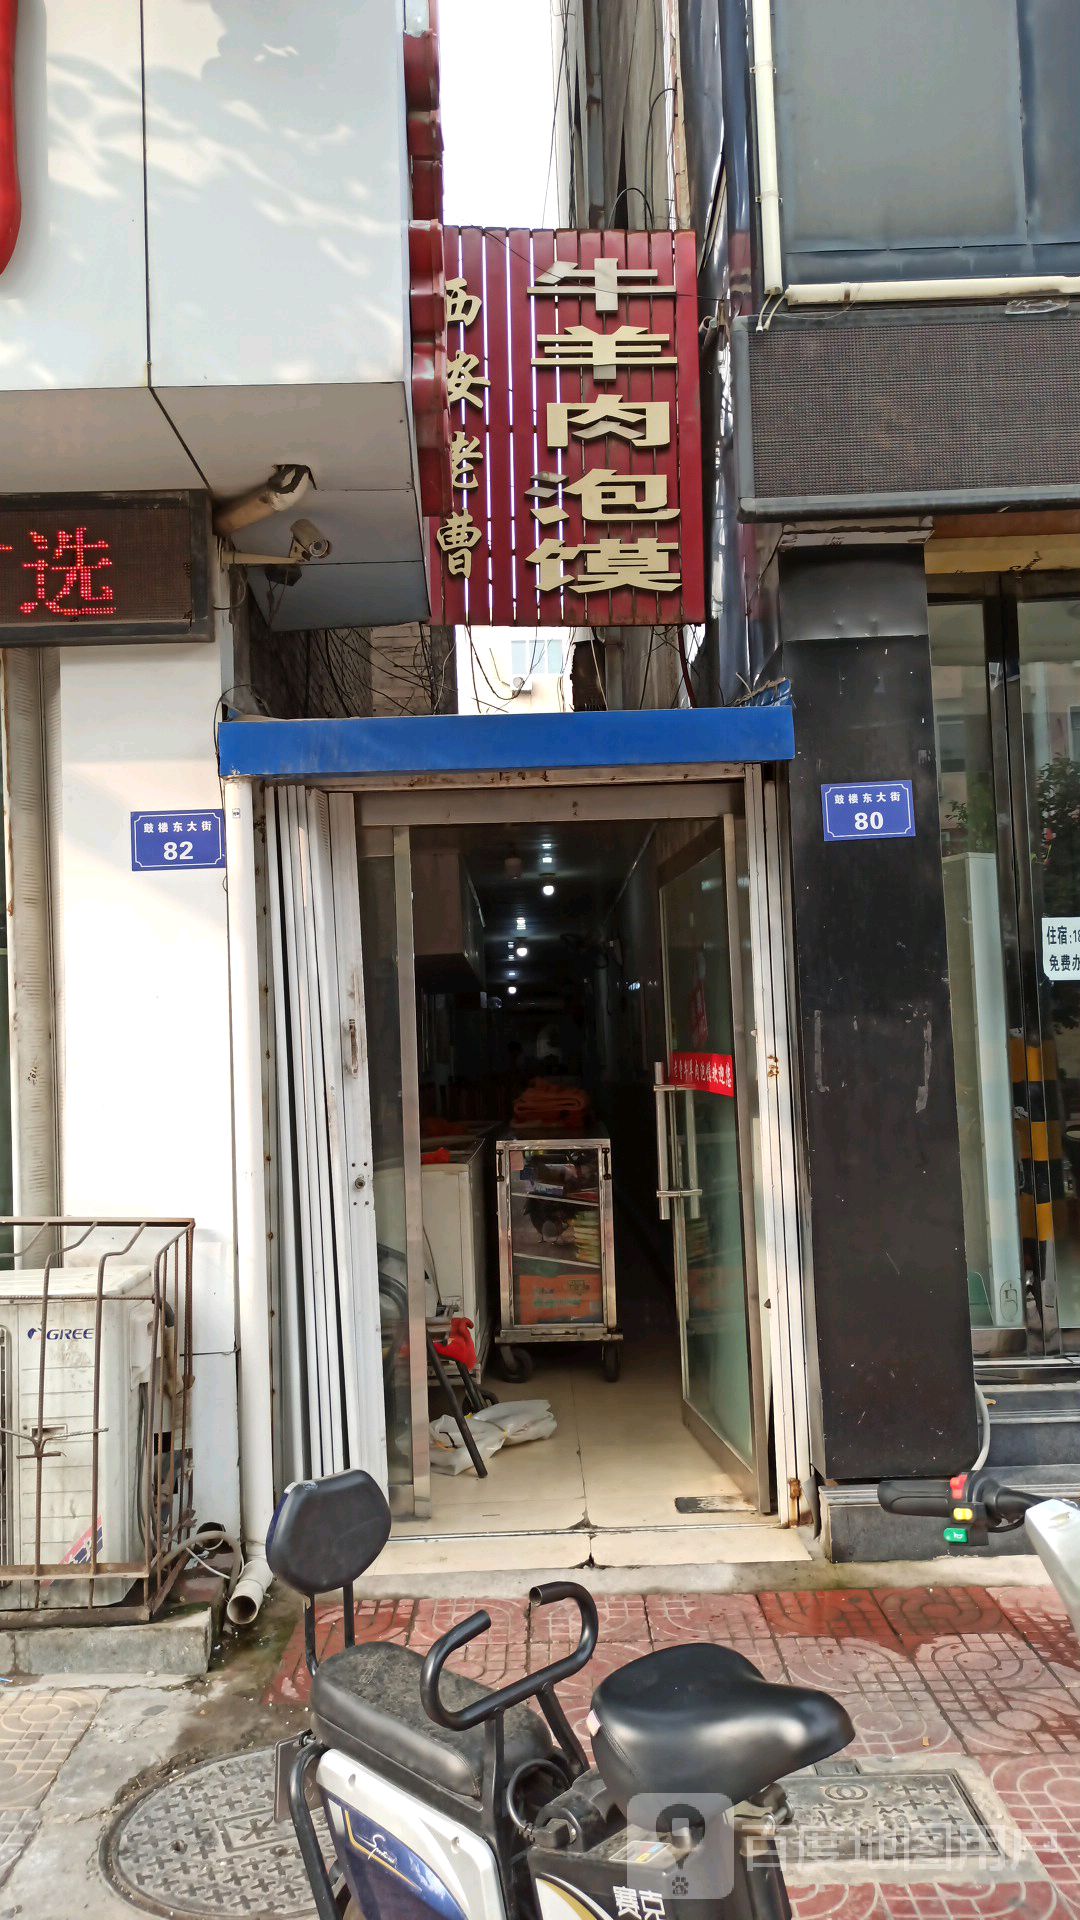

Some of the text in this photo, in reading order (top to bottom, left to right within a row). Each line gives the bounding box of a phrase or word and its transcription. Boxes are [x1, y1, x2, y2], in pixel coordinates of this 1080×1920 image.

[436, 277, 491, 580] 西安老曹
[524, 257, 683, 594] 牛羊肉泡馍
[0, 527, 116, 616] 选
[833, 791, 901, 805] 鼓楼东大街
[143, 820, 212, 834] 鼓楼东大街
[854, 811, 884, 830] 80
[163, 841, 194, 860] 82
[46, 1328, 95, 1340] GREE
